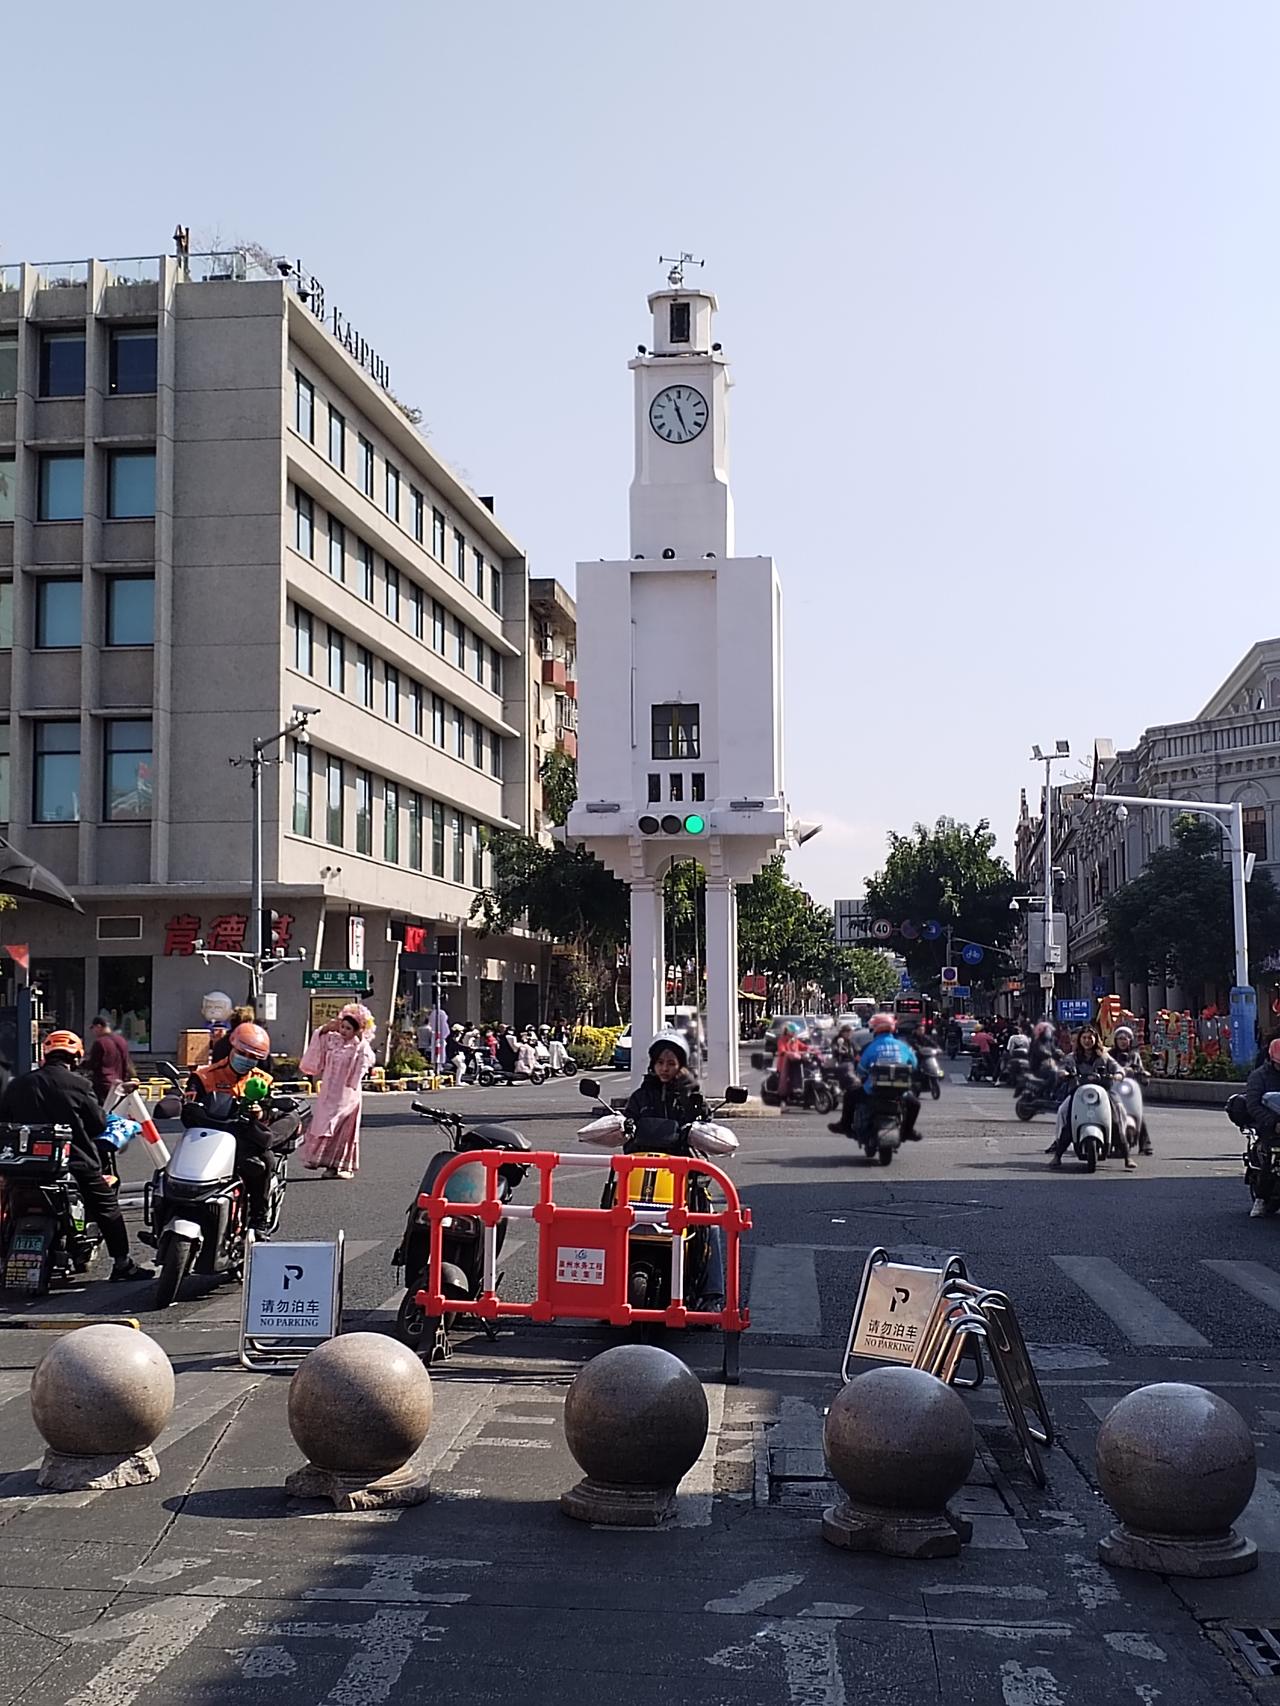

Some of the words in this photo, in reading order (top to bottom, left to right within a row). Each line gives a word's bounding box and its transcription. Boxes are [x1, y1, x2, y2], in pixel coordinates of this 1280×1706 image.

[875, 924, 888, 934] 40
[261, 1299, 319, 1314] 请勿泊车
[260, 1318, 274, 1327] NO
[276, 1317, 319, 1327] PARKING
[868, 1319, 918, 1339] 请勿泊车
[864, 1337, 877, 1348] NO
[877, 1339, 915, 1353] PARKING
